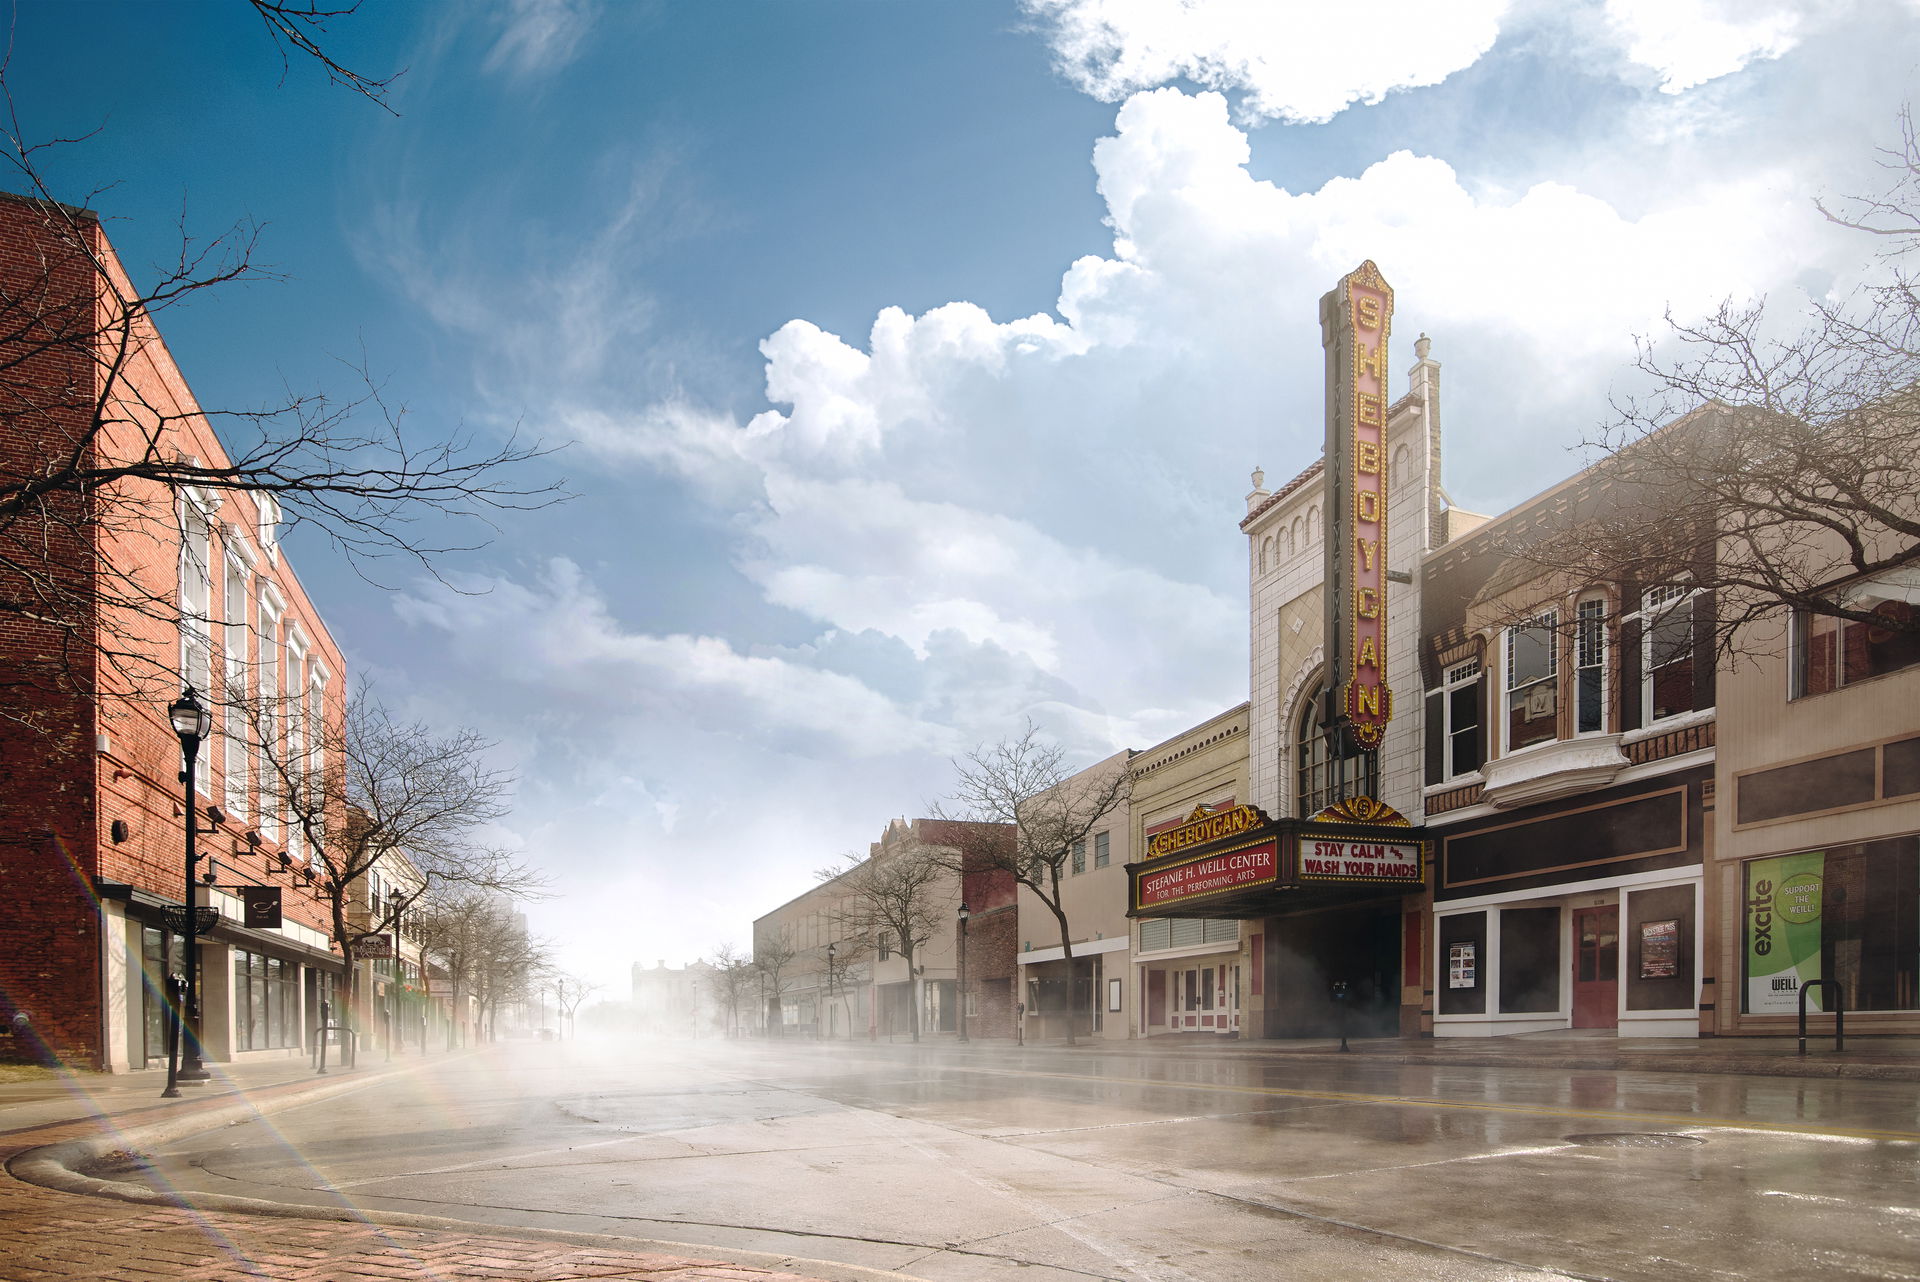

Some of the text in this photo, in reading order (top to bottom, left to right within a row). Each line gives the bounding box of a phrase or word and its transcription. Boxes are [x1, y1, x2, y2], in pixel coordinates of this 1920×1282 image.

[1358, 295, 1380, 716] SHEBOYGAN
[1160, 809, 1244, 852] SHEBOYGAN
[1314, 842, 1345, 857] STAY
[1350, 844, 1385, 859] CALM
[1146, 852, 1271, 894] STEFANIE H. WEILL CENTER
[1304, 859, 1417, 877] WASH YOUR HANDS
[1156, 869, 1256, 900] FOR THE PERFORMING ARTS
[1784, 883, 1820, 895] SUPPORT
[1794, 894, 1809, 904] THE
[1749, 879, 1773, 956] excite
[1789, 904, 1816, 914] WEILL!
[1771, 978, 1798, 991] WEILL
